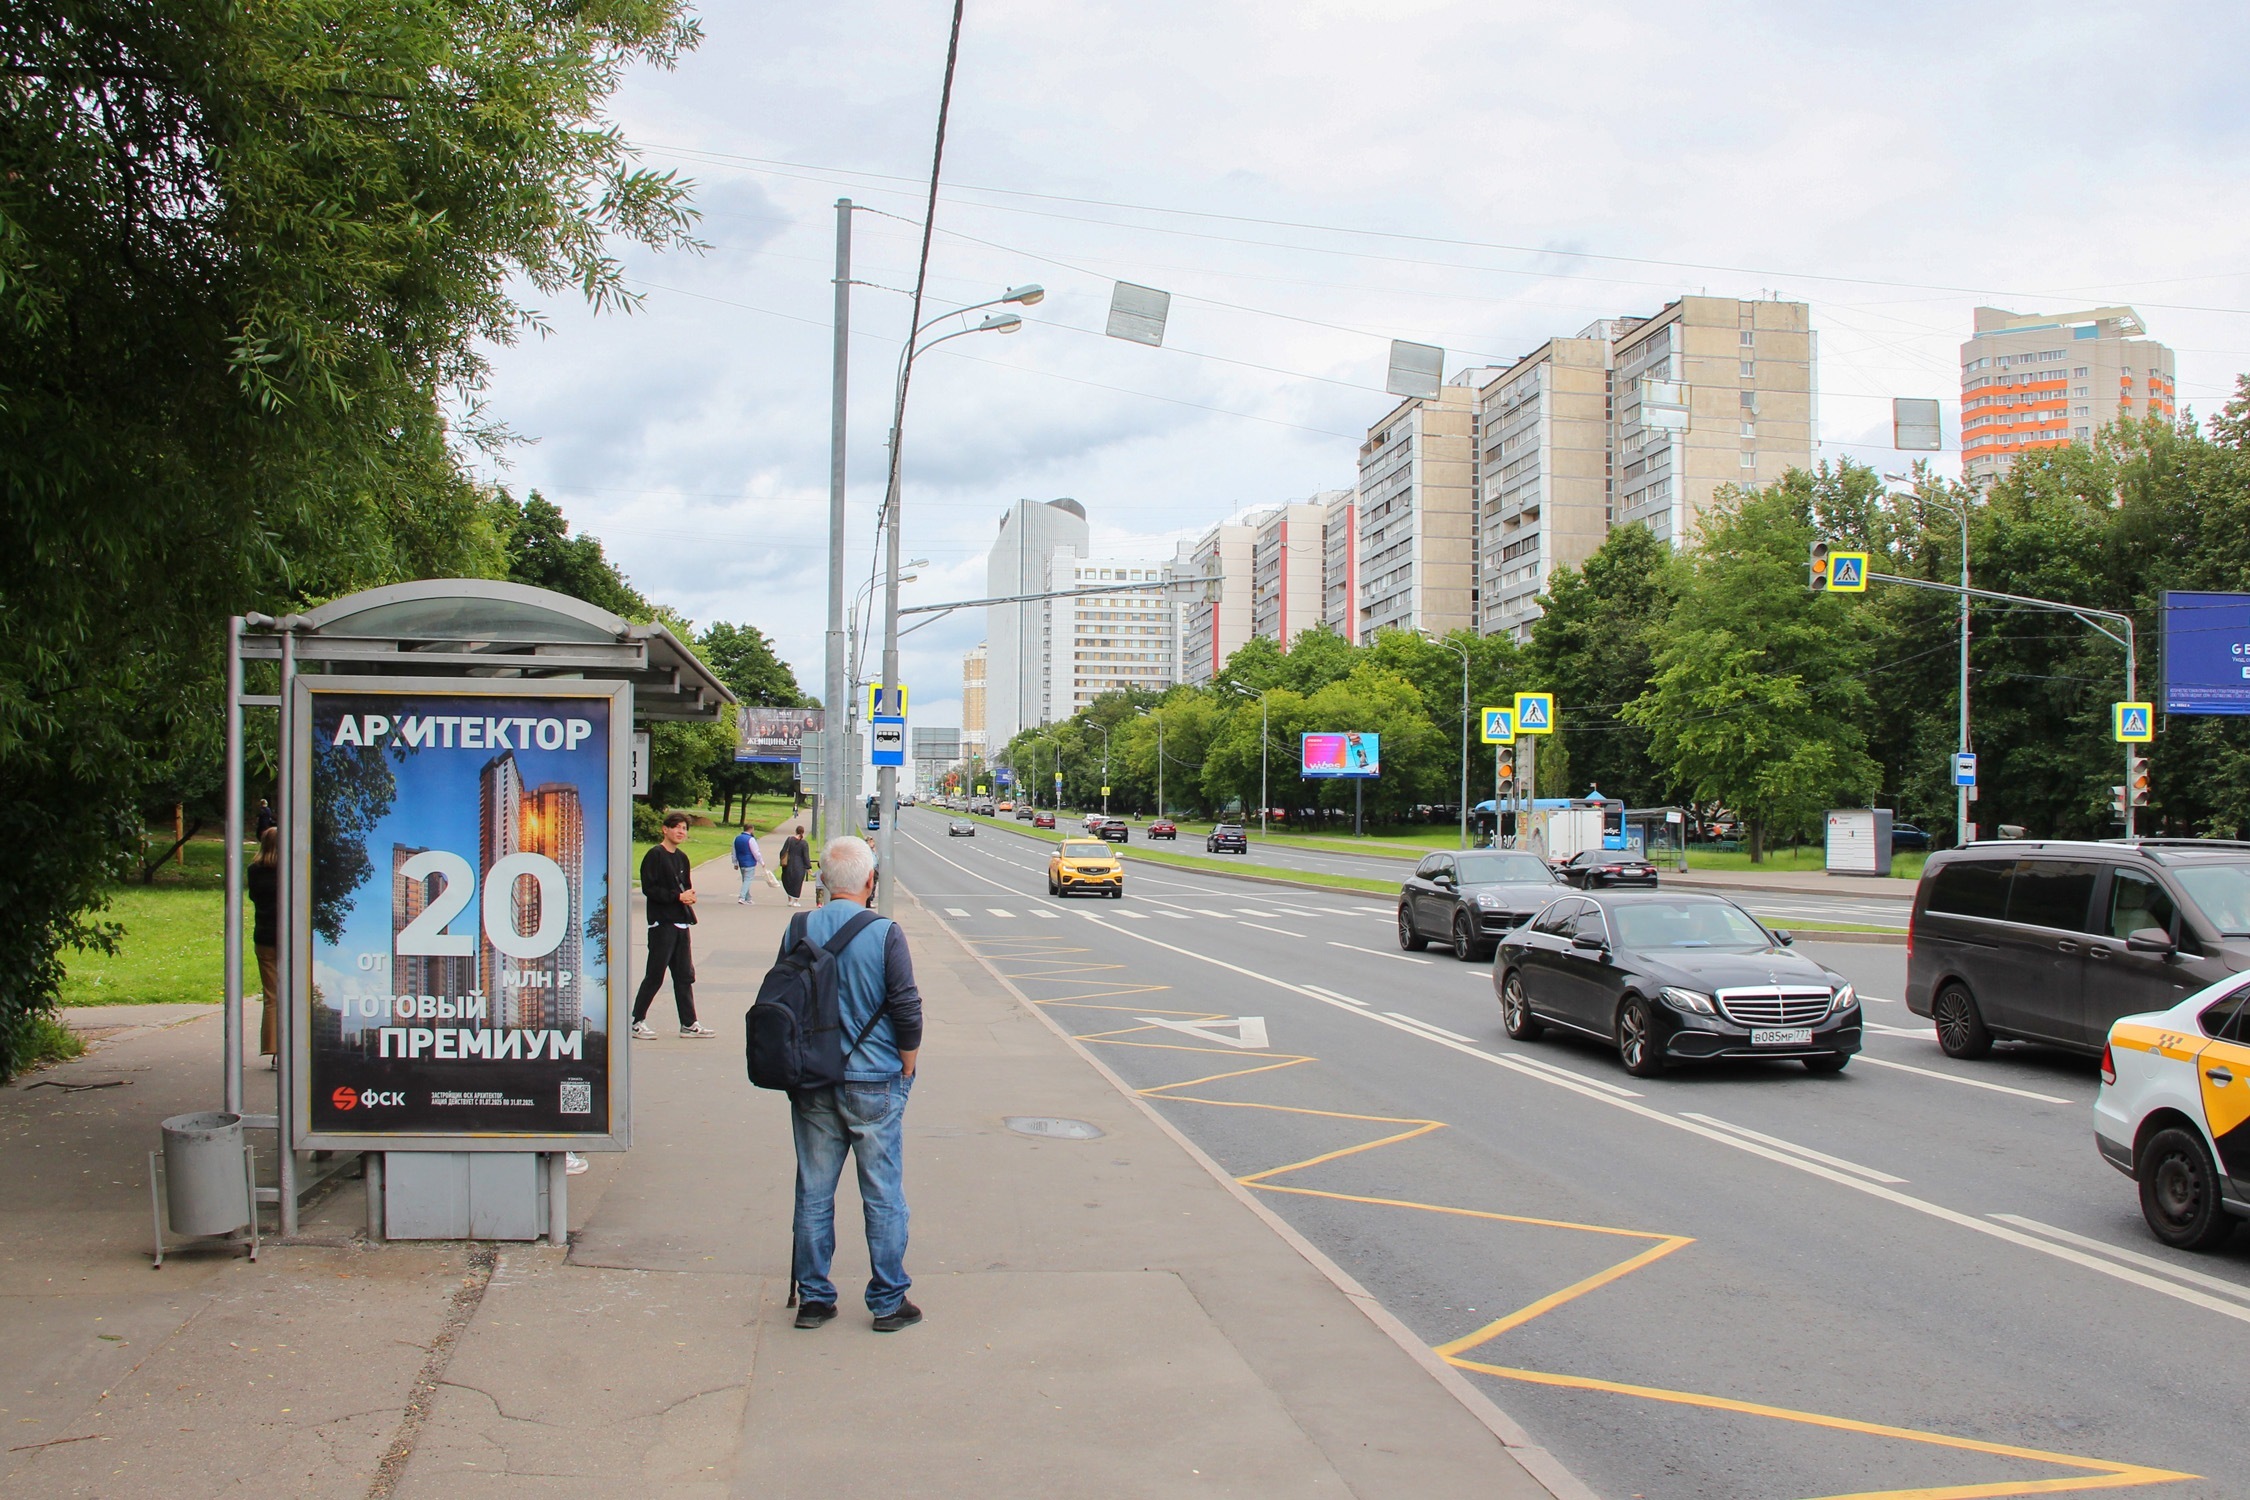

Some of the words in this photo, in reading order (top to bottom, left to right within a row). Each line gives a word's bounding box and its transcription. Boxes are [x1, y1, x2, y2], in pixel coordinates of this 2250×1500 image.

[333, 714, 592, 750] АРХИТЕКТОР
[747, 737, 787, 746] ЖЕНЩИНЫ
[1627, 837, 1640, 848] 20
[396, 851, 570, 959] 20
[357, 952, 386, 971] ОТ
[502, 970, 552, 989] МЛН
[343, 989, 487, 1019] ГОТОВЫЙ
[379, 1027, 583, 1060] ПРЕМИУМ
